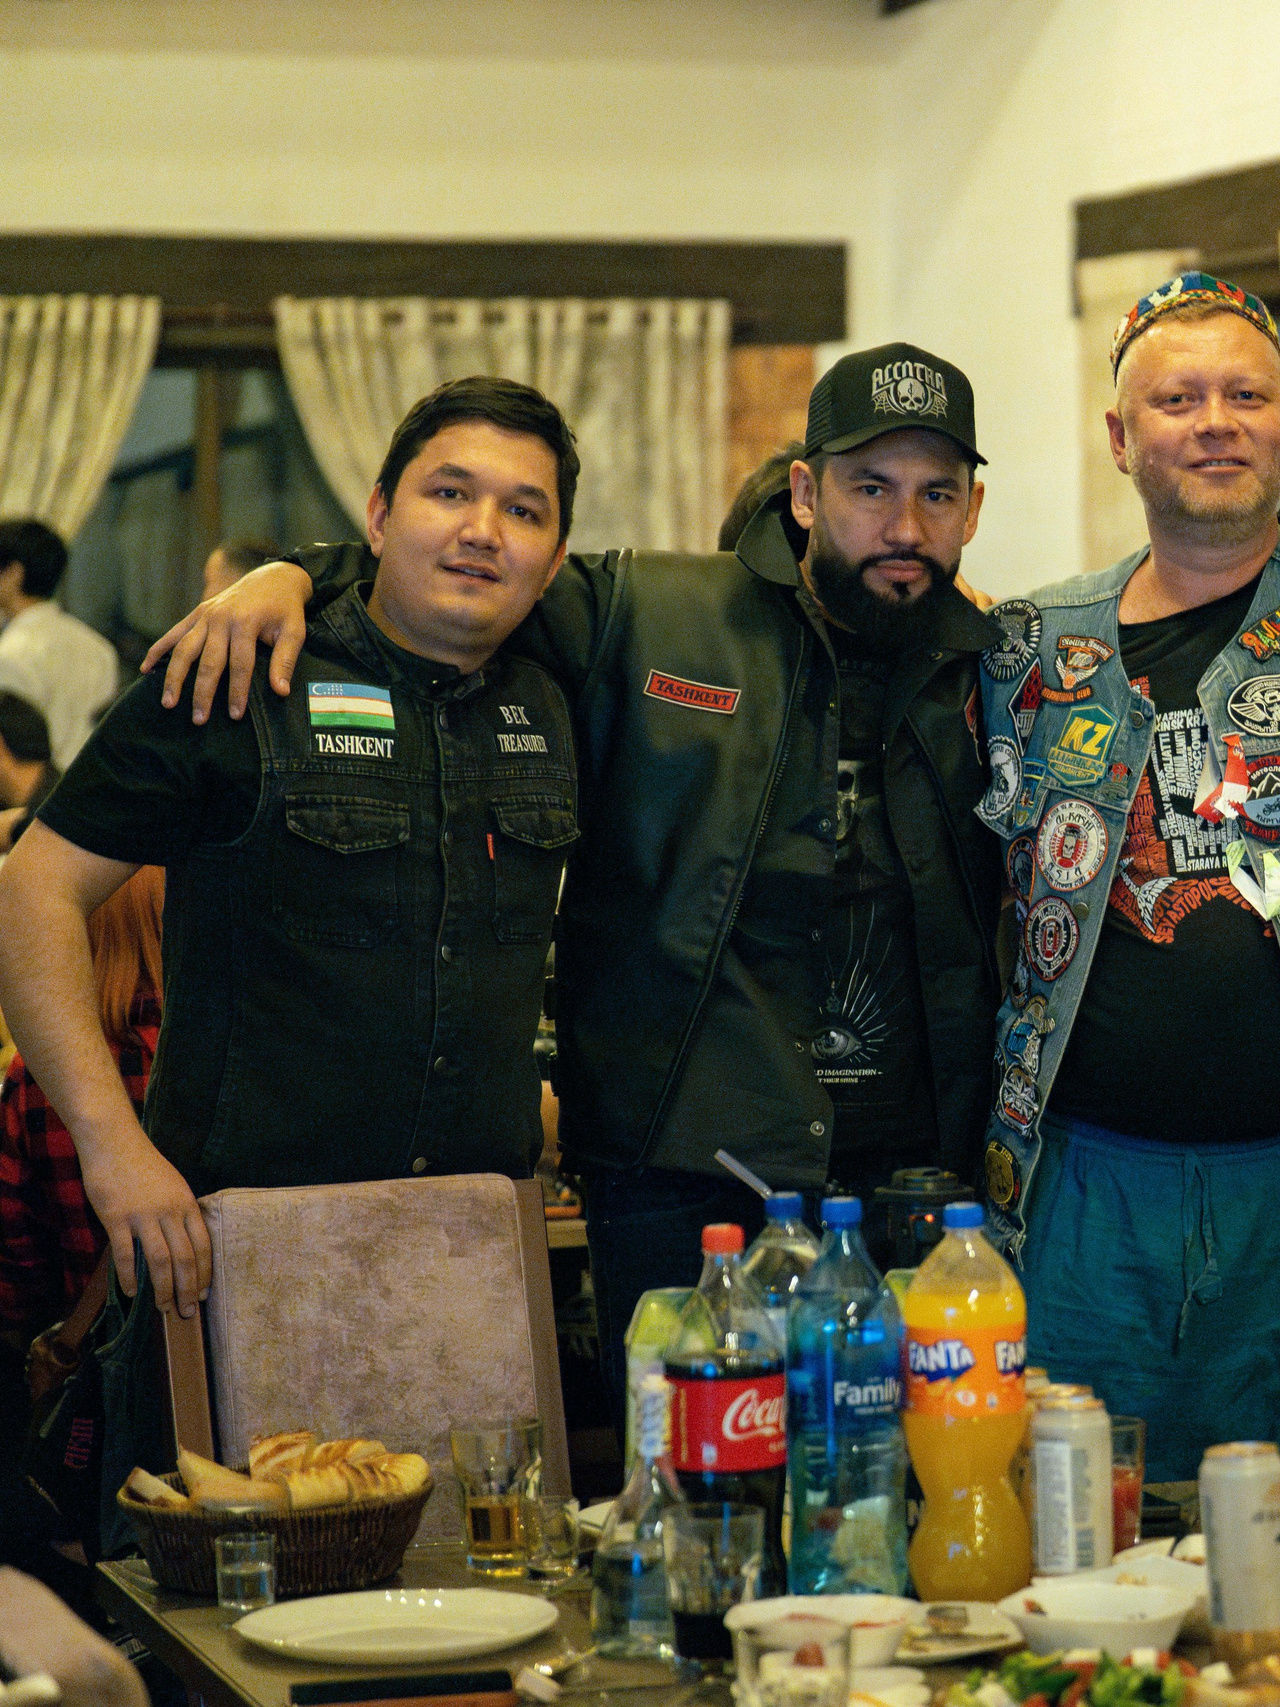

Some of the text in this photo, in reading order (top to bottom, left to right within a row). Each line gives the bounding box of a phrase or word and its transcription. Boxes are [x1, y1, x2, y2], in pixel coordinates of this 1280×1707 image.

[656, 678, 731, 707] TASHKENT
[499, 705, 531, 726] BEK
[315, 733, 394, 759] TASHKENT
[497, 733, 549, 754] TREASURER
[1061, 716, 1112, 756] KZ
[1159, 732, 1176, 785] TOGLIATTI
[1157, 769, 1180, 838] CHELYABINSK
[1187, 857, 1221, 872] STARAYA
[1152, 878, 1219, 944] SEVASTOPOL
[824, 1068, 877, 1077] IMAGINATION
[908, 1340, 975, 1371] FANTA
